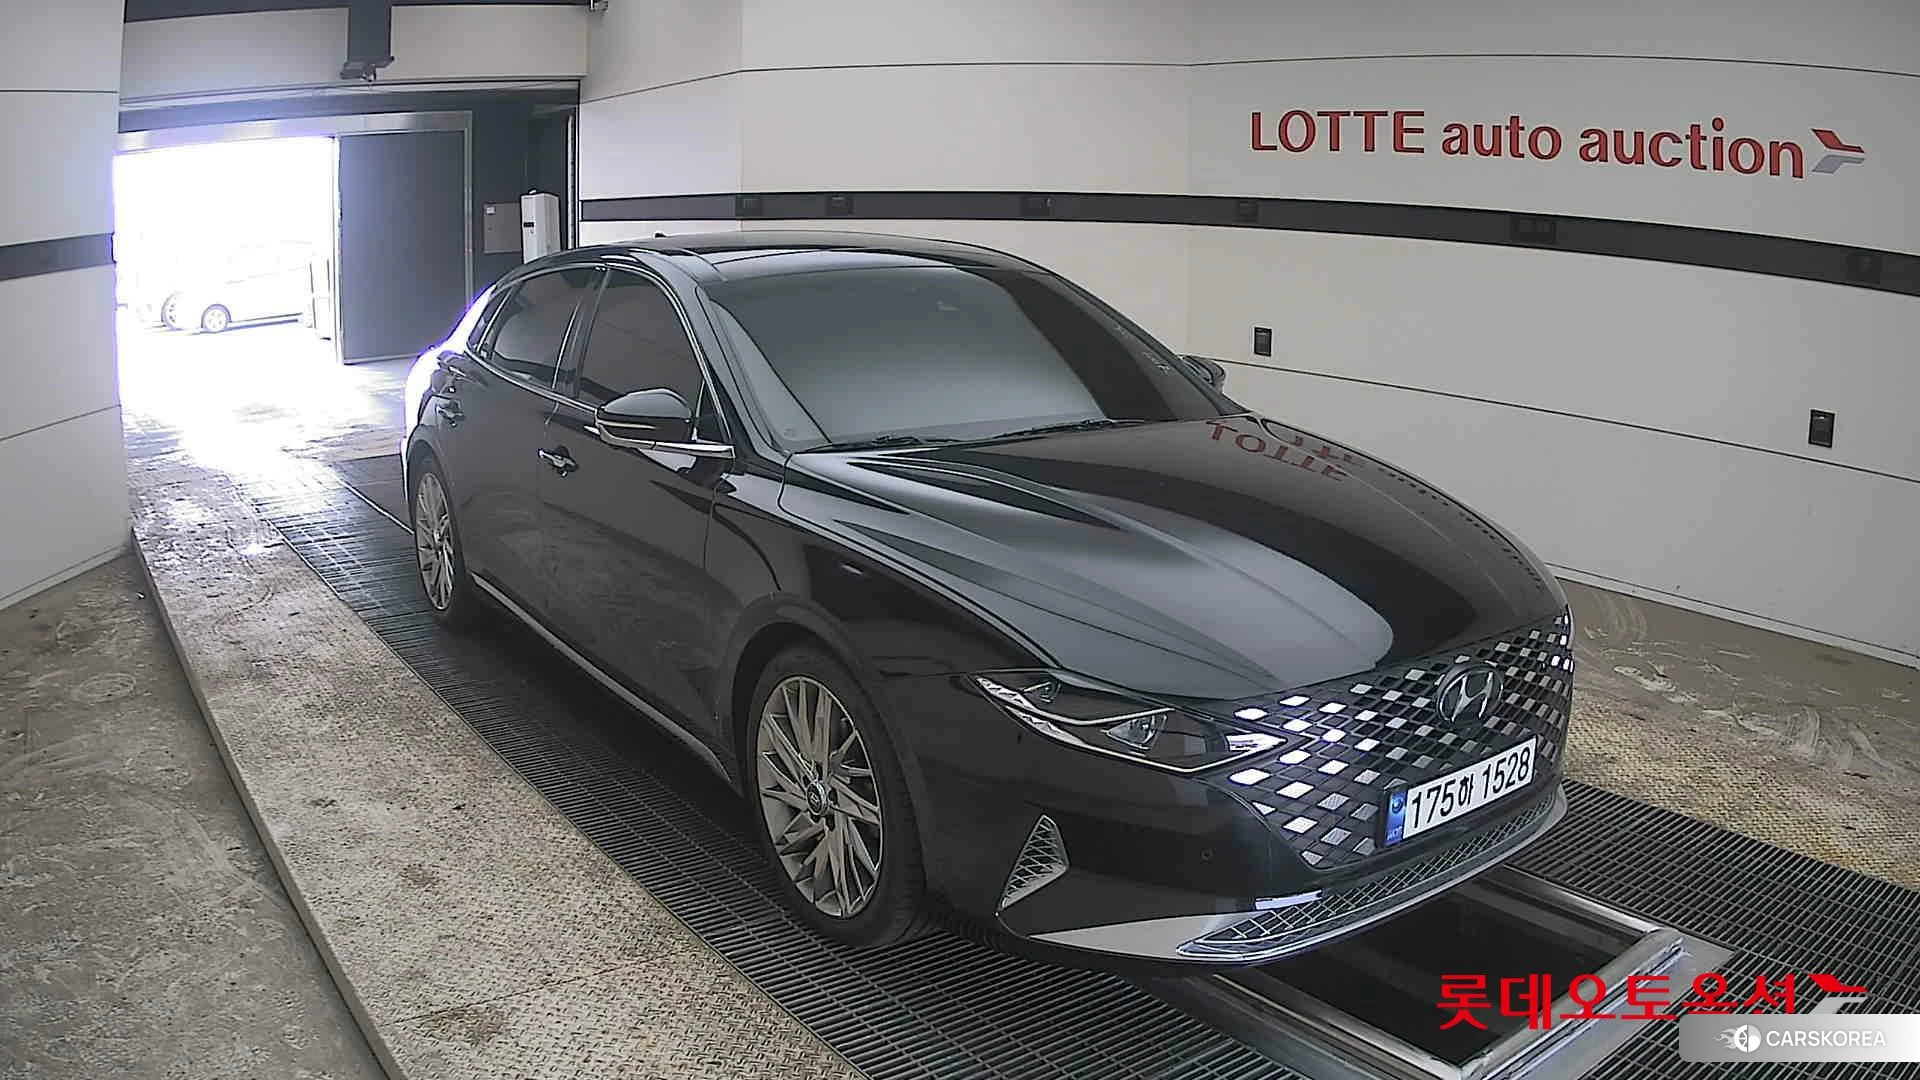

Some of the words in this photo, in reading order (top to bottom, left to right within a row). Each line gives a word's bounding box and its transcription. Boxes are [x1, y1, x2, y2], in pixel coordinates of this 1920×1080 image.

[1251, 110, 1425, 155] LOTTE
[1440, 116, 1562, 161] auto
[1578, 117, 1805, 179] auction
[1411, 773, 1475, 829] 175하
[1482, 746, 1531, 799] 1528
